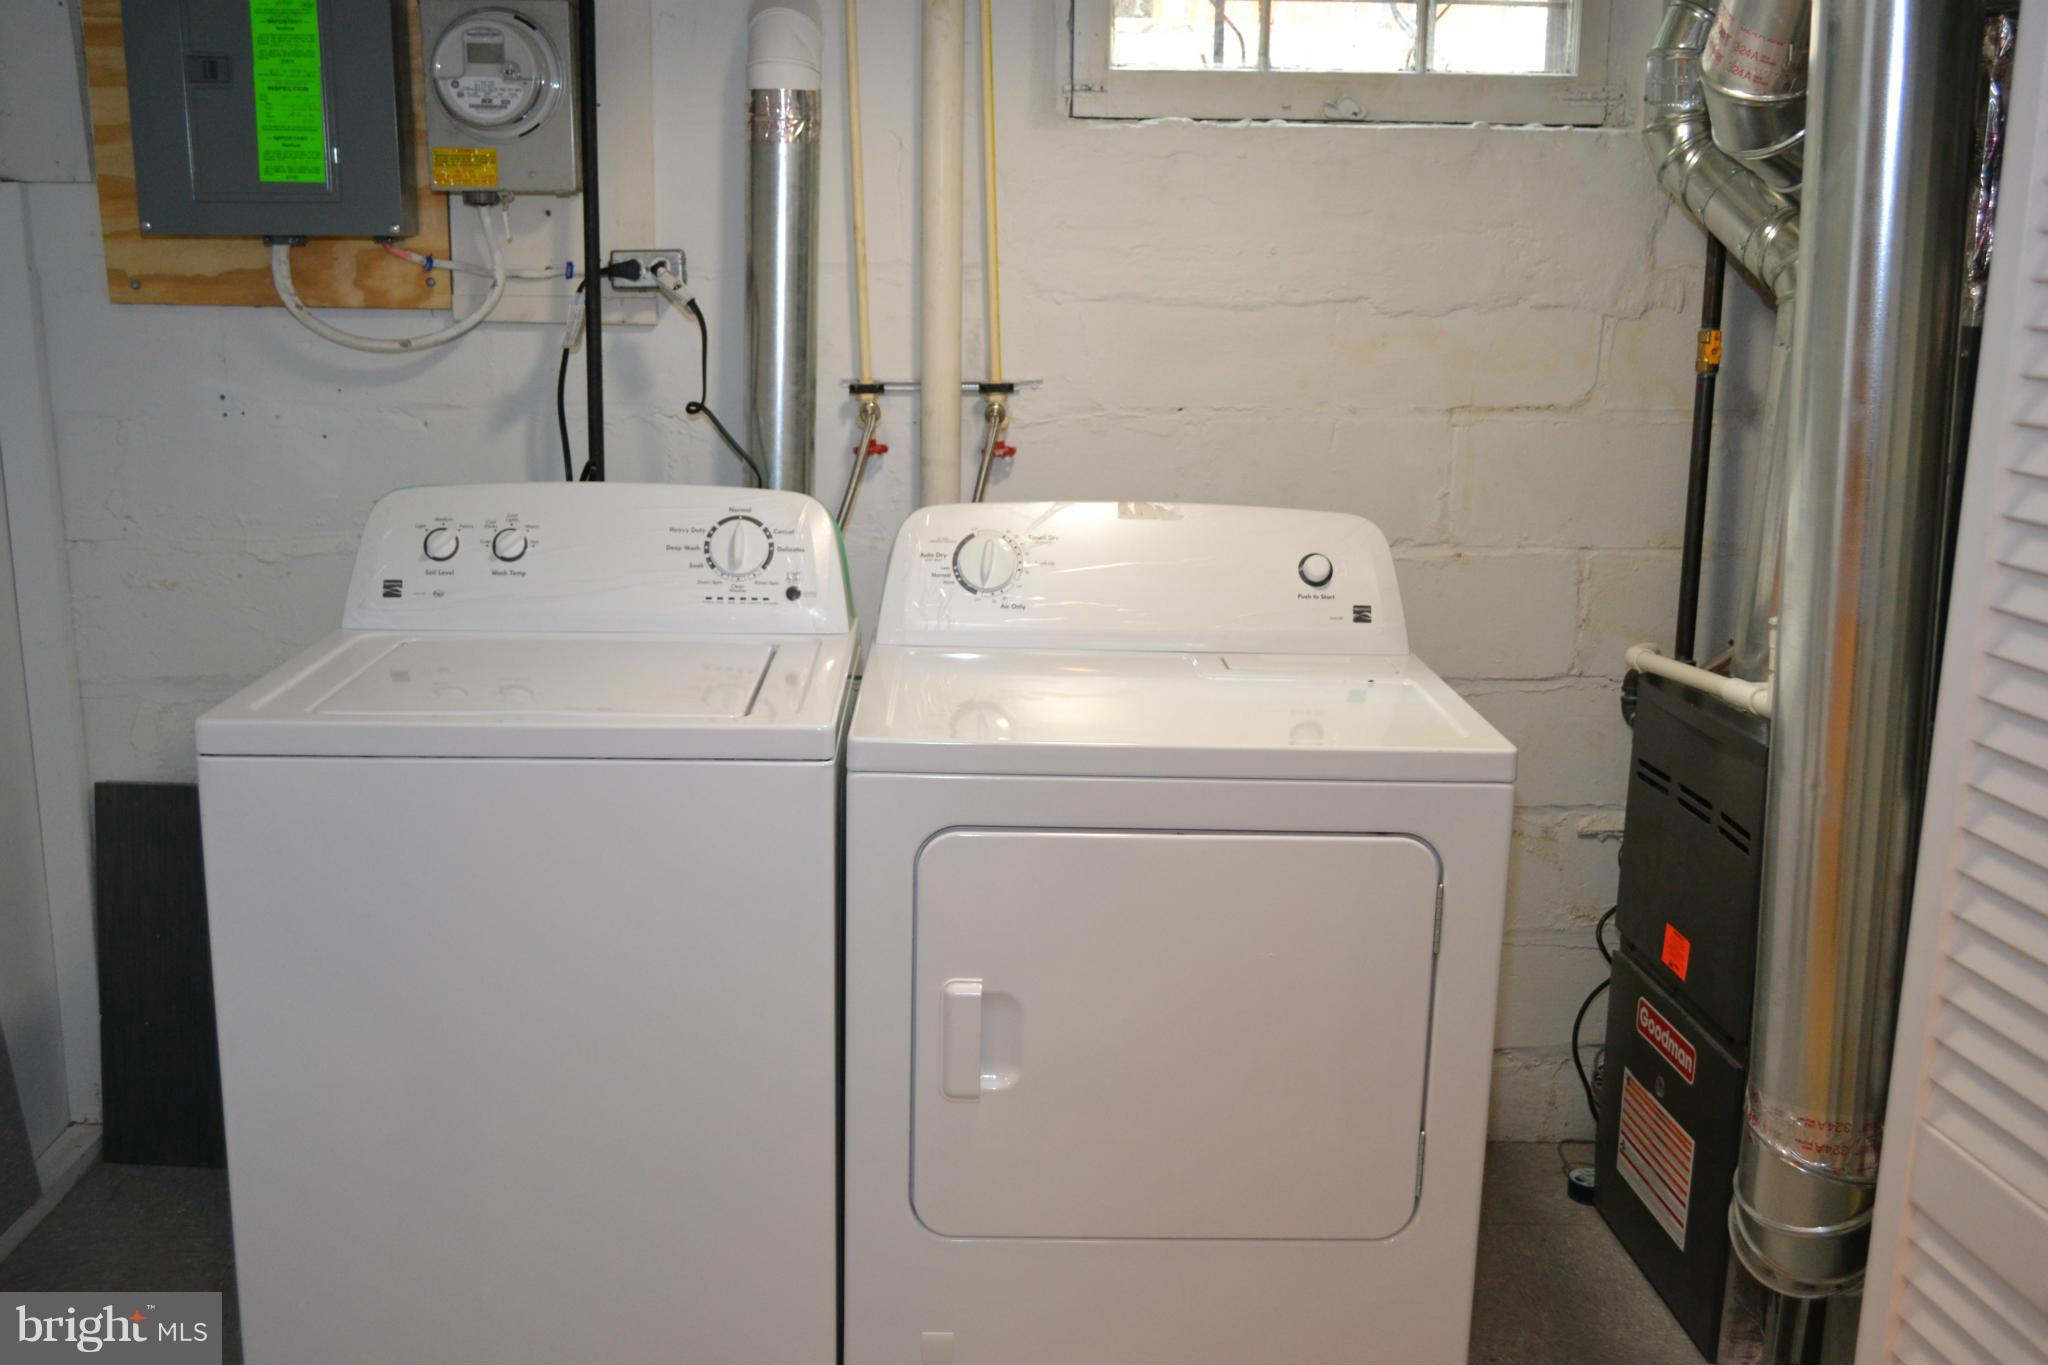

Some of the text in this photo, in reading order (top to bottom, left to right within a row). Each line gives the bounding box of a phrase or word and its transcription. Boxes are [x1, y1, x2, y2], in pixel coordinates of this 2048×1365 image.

[665, 544, 683, 552] Deep
[1011, 603, 1026, 611] Only
[1640, 1006, 1693, 1074] Goodman
[1816, 1121, 1851, 1133] 324A
